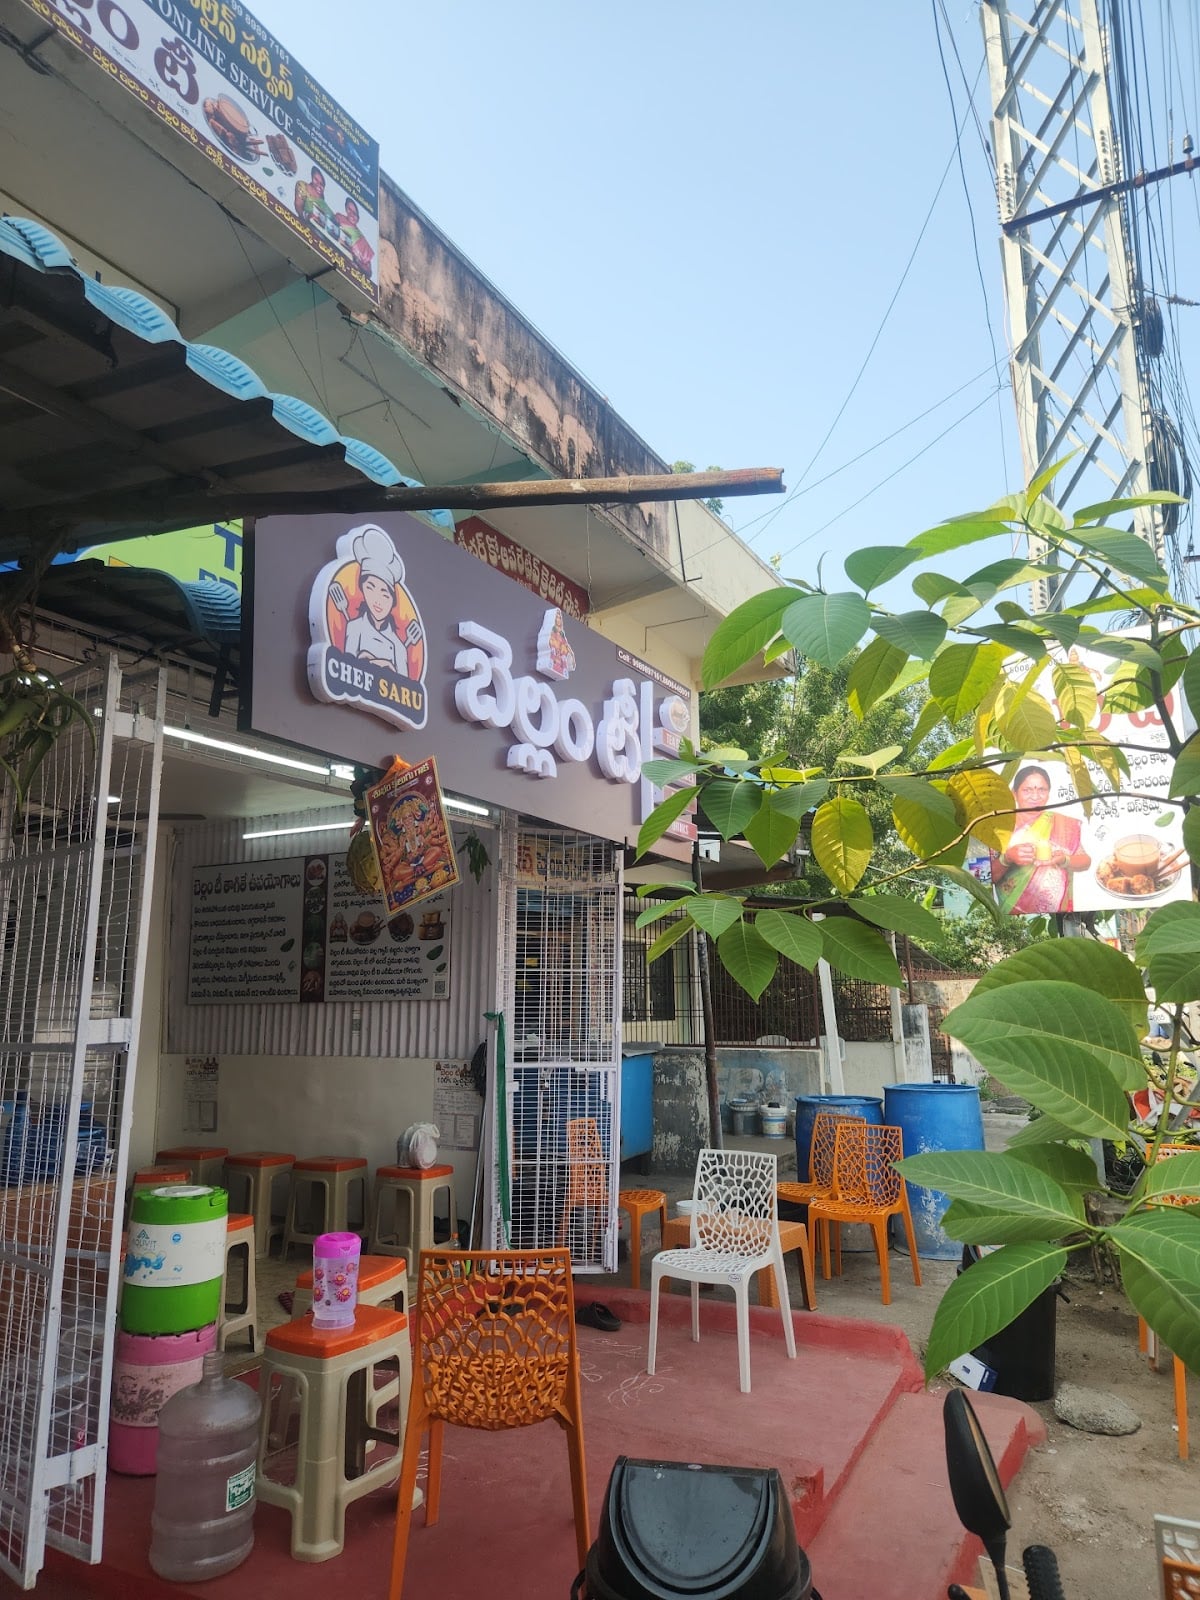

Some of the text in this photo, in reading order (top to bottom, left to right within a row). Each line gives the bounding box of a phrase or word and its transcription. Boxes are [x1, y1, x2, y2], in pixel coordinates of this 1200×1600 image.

[154, 35, 200, 105] టీ
[159, 0, 294, 136] ONLINE SERVICE
[240, 31, 294, 101] సర్వీస్
[328, 658, 422, 710] CHEF SARU
[453, 621, 643, 784] బెల్లం టీ
[194, 880, 212, 900] బెల్లం
